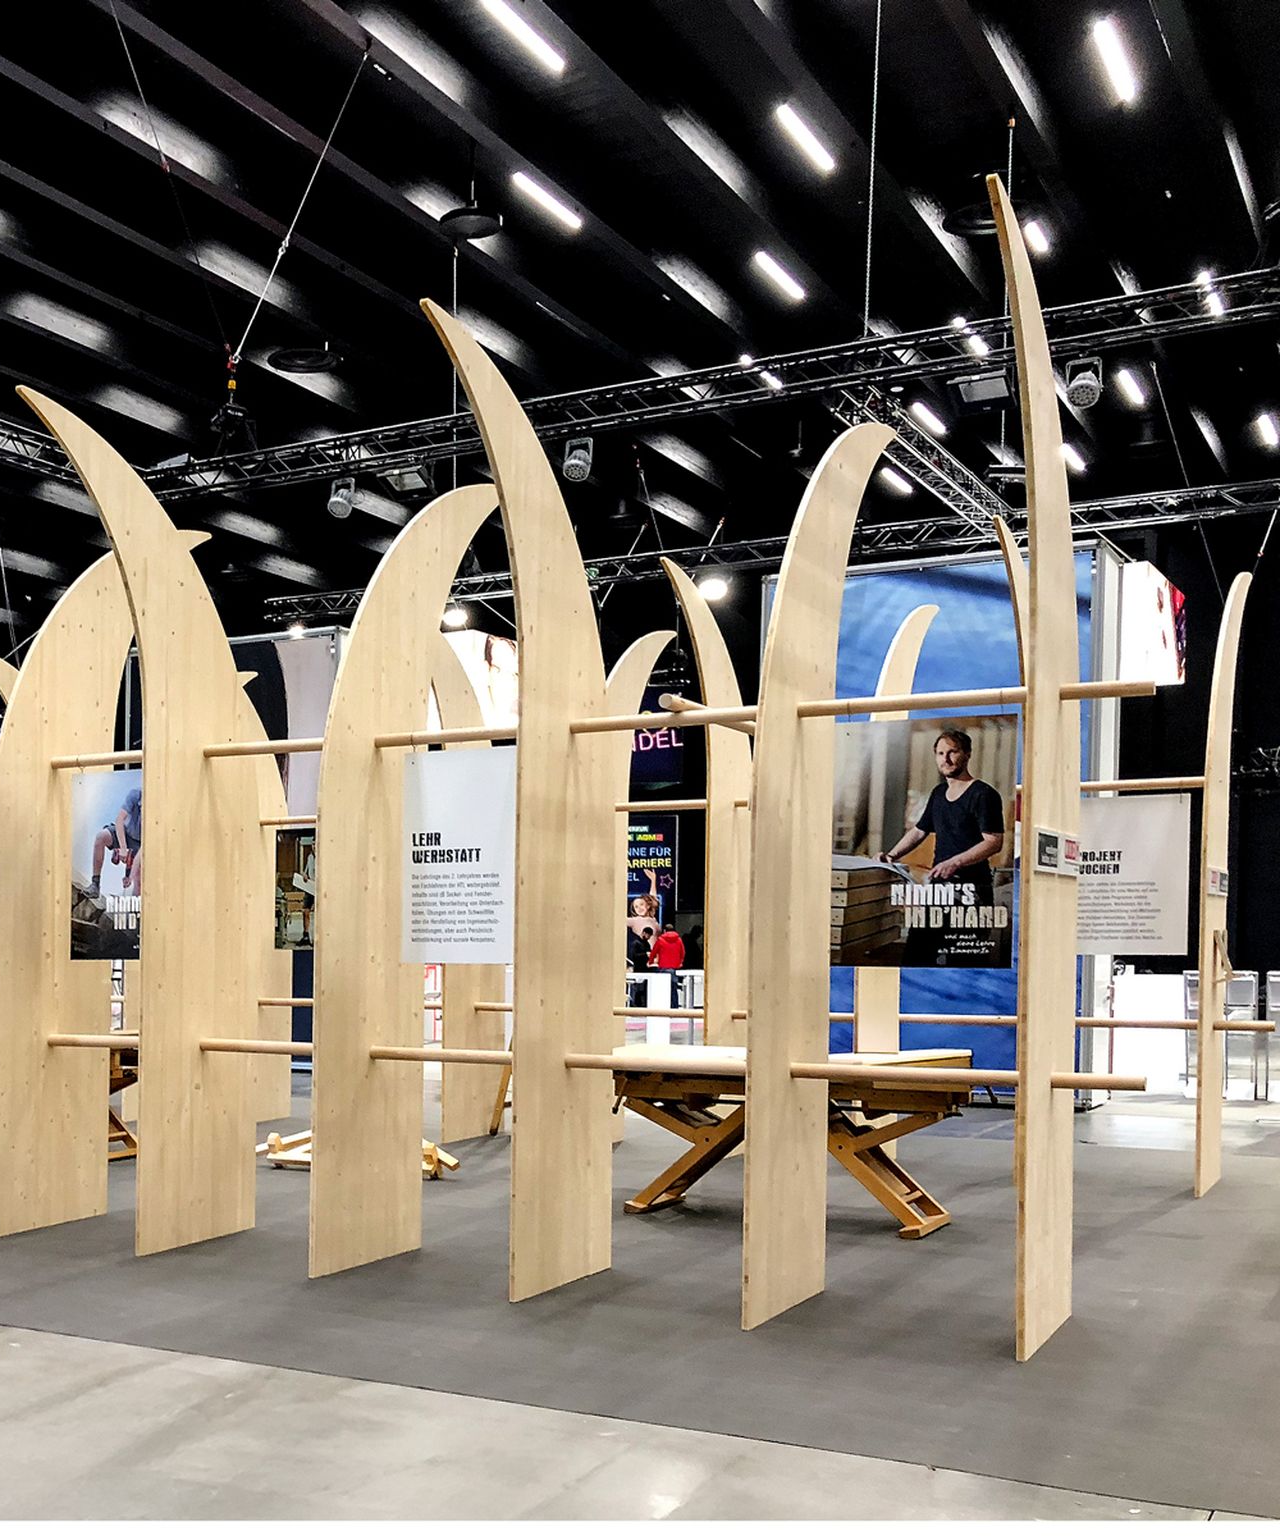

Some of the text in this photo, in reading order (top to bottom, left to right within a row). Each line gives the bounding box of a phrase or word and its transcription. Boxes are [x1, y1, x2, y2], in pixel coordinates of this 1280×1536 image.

[412, 832, 441, 847] LEHR
[412, 848, 481, 864] WERKSTATT
[649, 845, 672, 857] FÜR
[1079, 851, 1123, 862] ROJEKT
[890, 883, 976, 906] NIMM'S
[114, 913, 127, 930] IN
[904, 906, 1008, 929] IN D'HAND
